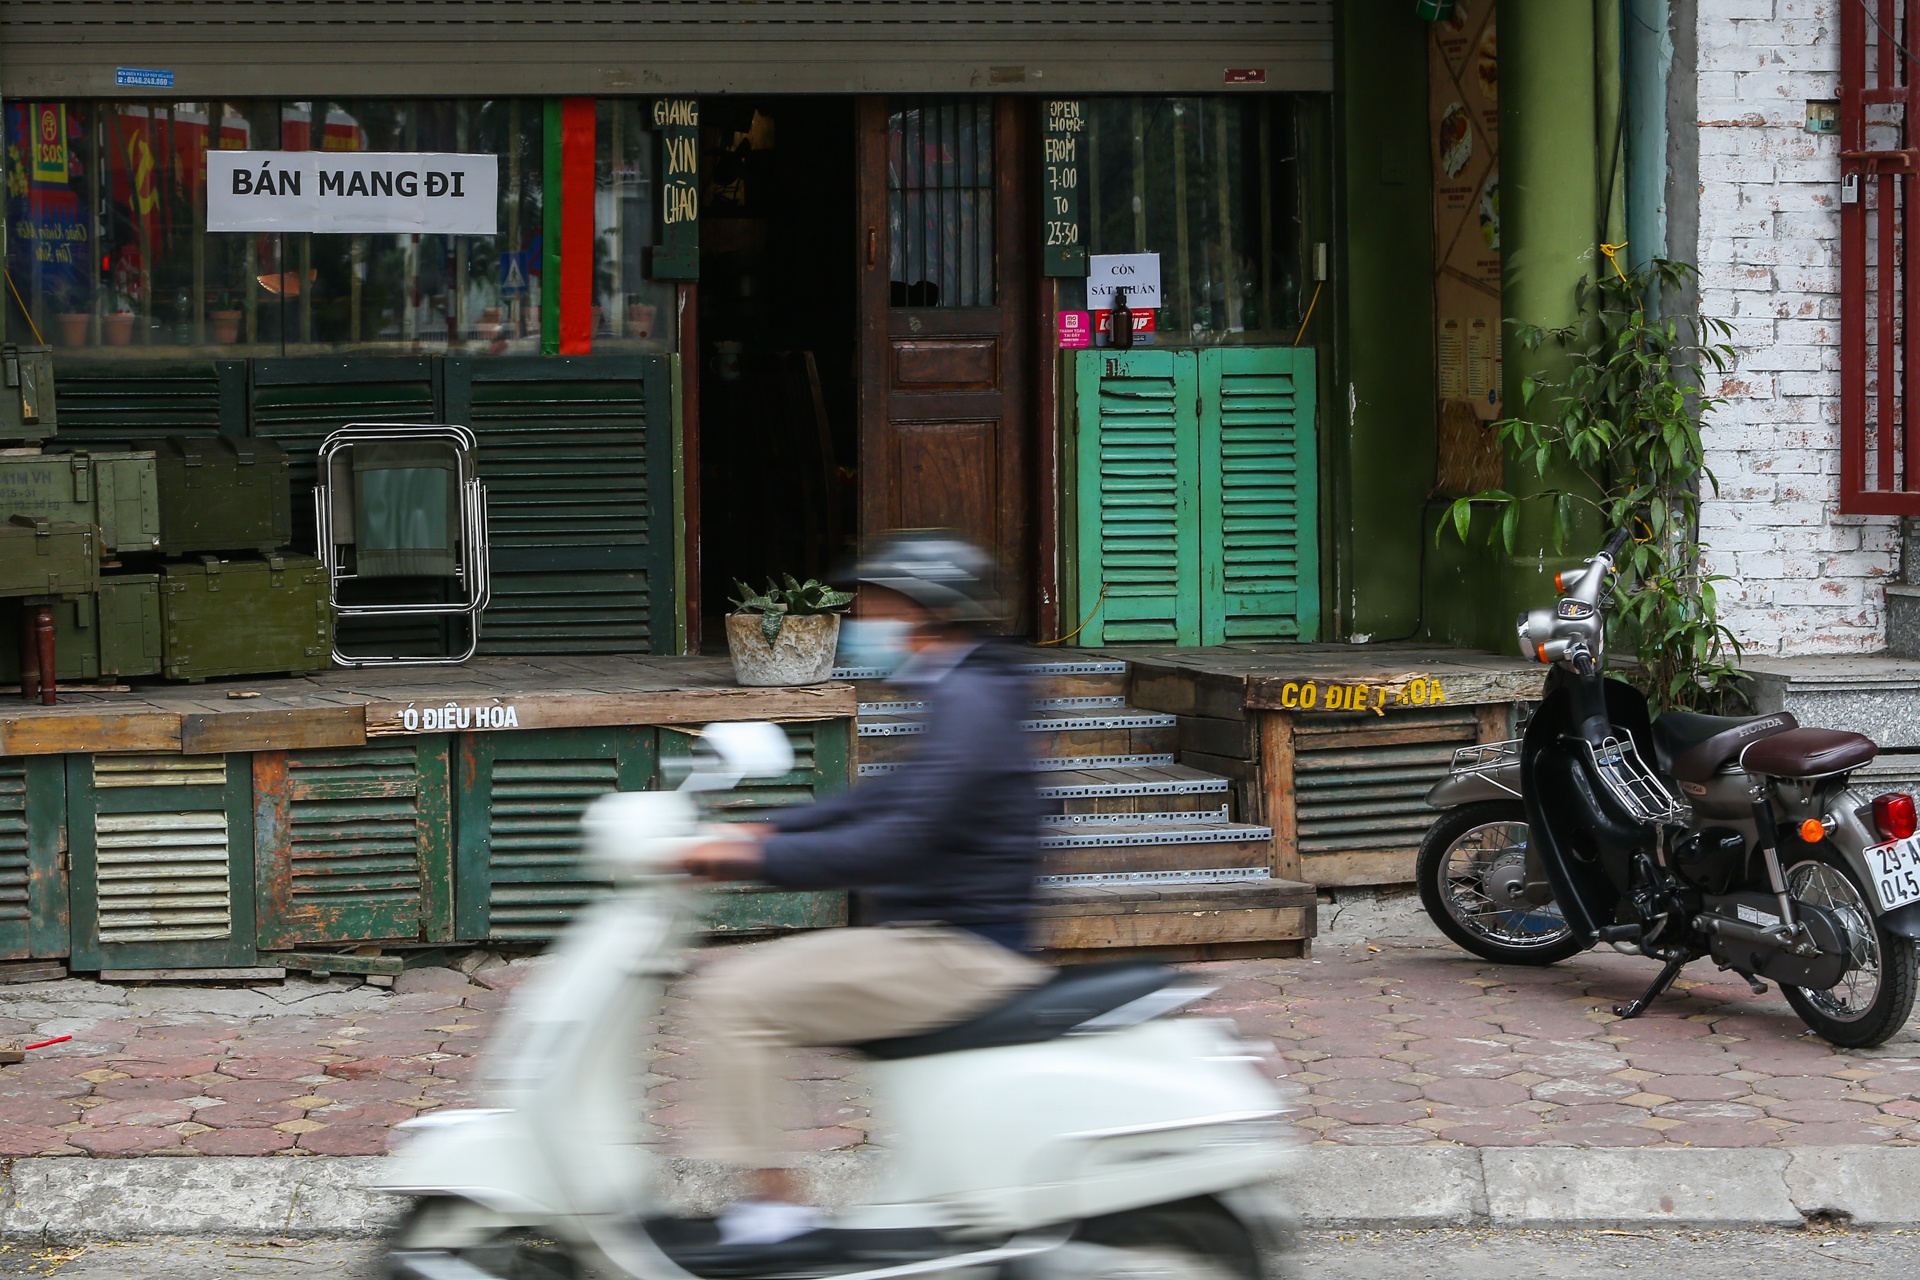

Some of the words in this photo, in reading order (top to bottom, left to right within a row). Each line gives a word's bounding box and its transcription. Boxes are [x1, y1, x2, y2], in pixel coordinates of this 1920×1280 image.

[1050, 102, 1080, 118] OPEN
[1046, 138, 1075, 163] FROM
[233, 161, 301, 196] BÁN
[319, 170, 418, 197] MANG
[424, 172, 465, 197] ĐI
[1048, 166, 1077, 191] 7:00
[664, 180, 697, 224] CHÀO
[1054, 196, 1069, 215] TO
[1047, 221, 1078, 245] 23:30
[1091, 284, 1113, 295] SÁT
[422, 702, 471, 730] ĐIỀU
[476, 698, 519, 728] HÒA
[1738, 718, 1784, 738] HONDA
